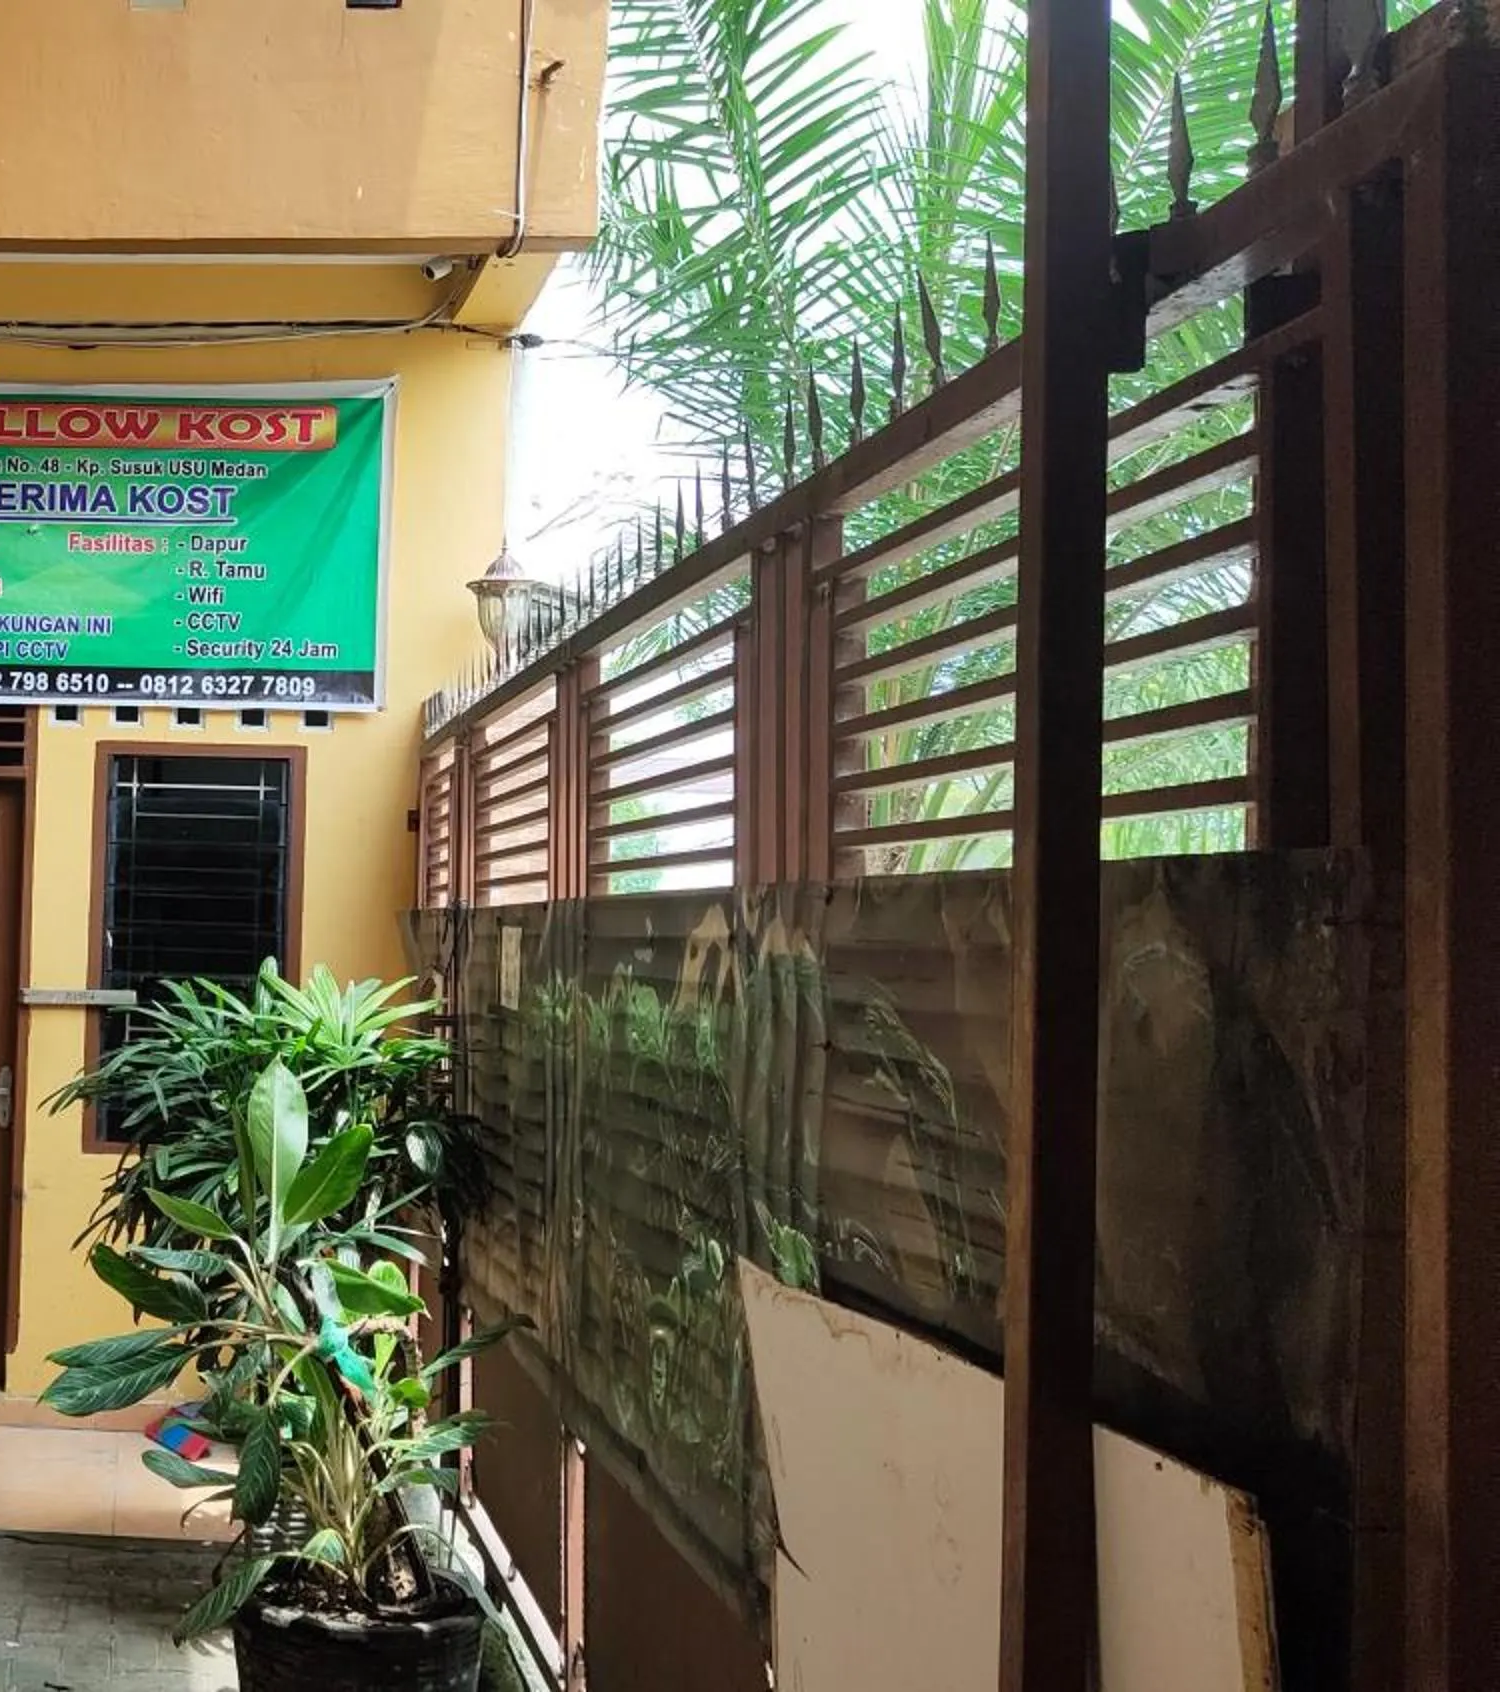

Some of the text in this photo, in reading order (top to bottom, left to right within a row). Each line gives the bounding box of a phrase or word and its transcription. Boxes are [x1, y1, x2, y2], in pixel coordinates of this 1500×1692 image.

[176, 409, 325, 444] KOST
[7, 456, 35, 474] No.
[40, 457, 60, 474] 48
[77, 459, 105, 477] Kp.
[110, 459, 163, 477] Susuk
[169, 461, 205, 478] USU
[211, 461, 268, 479] Medan
[128, 484, 237, 516] KOST
[67, 532, 155, 553] Fasilitas
[189, 534, 248, 555] Dapur
[188, 559, 209, 579] R.
[215, 561, 266, 580] Tamu
[188, 585, 224, 605] Wifi
[86, 616, 113, 635] INI
[186, 613, 242, 632] CCTV
[16, 640, 68, 660] CCTV
[186, 638, 264, 661] Security
[271, 641, 293, 658] 24
[298, 641, 339, 659] Jam
[9, 672, 49, 691] 798
[55, 673, 109, 692] 6510
[139, 675, 194, 694] 0812
[201, 676, 255, 695] 6327
[262, 676, 316, 696] 7809
